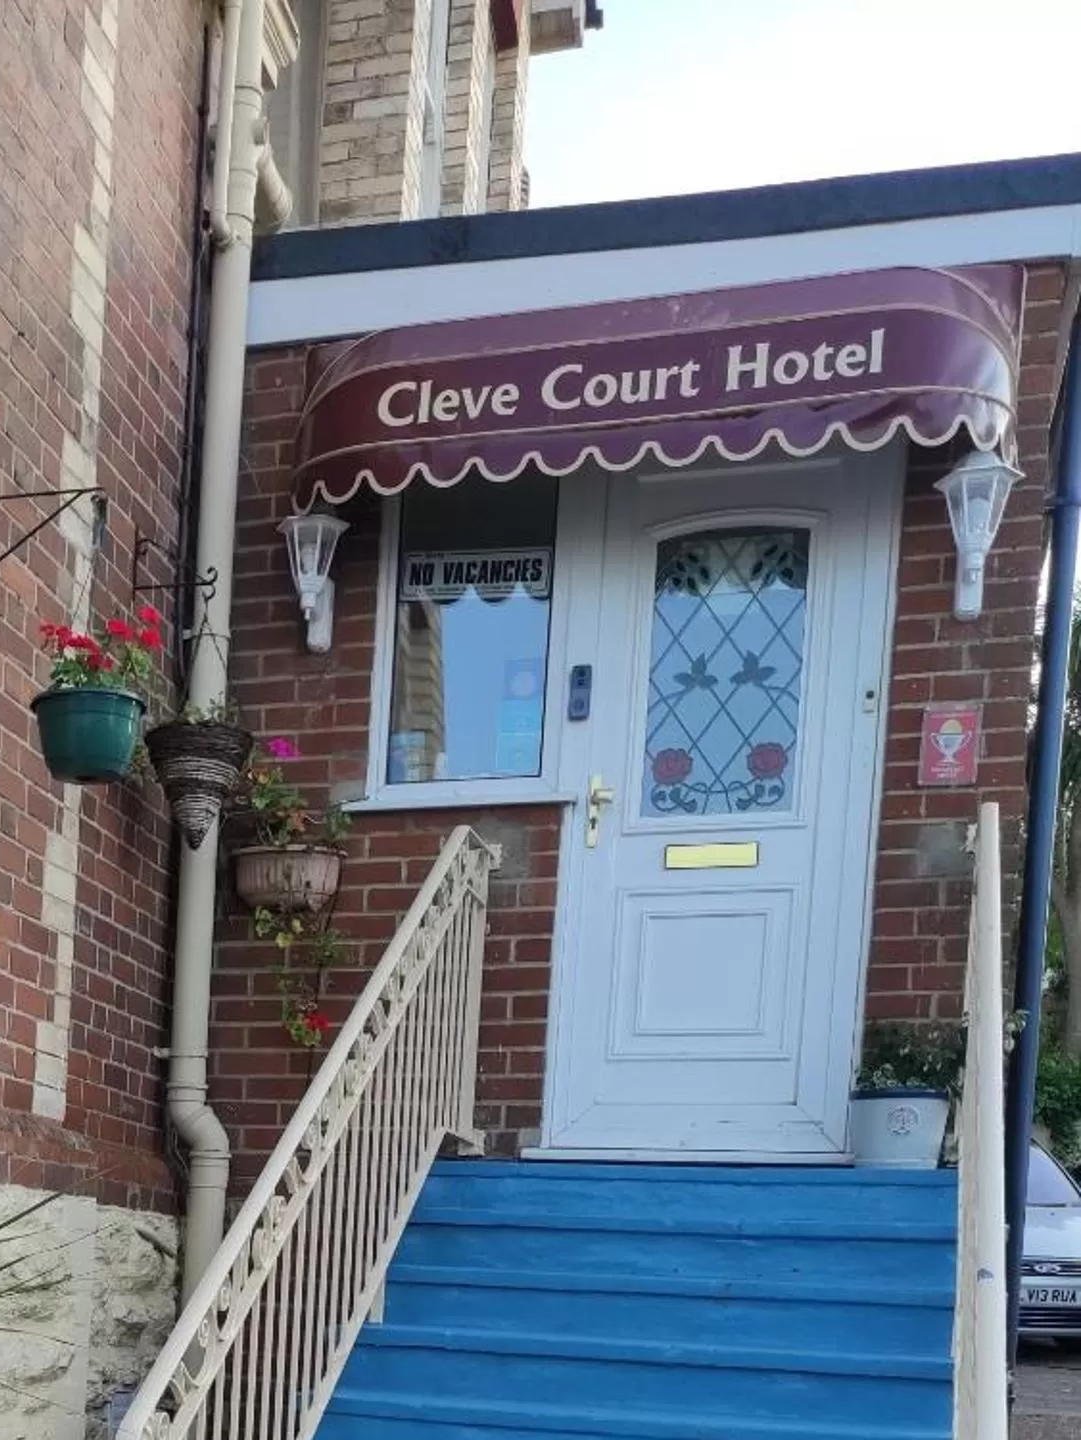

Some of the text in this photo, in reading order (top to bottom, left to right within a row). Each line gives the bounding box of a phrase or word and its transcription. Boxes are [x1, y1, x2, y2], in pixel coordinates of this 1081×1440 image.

[377, 328, 886, 427] Cleve Court Hotel
[409, 557, 544, 586] NO VACANCIES
[1020, 1288, 1049, 1303] V13
